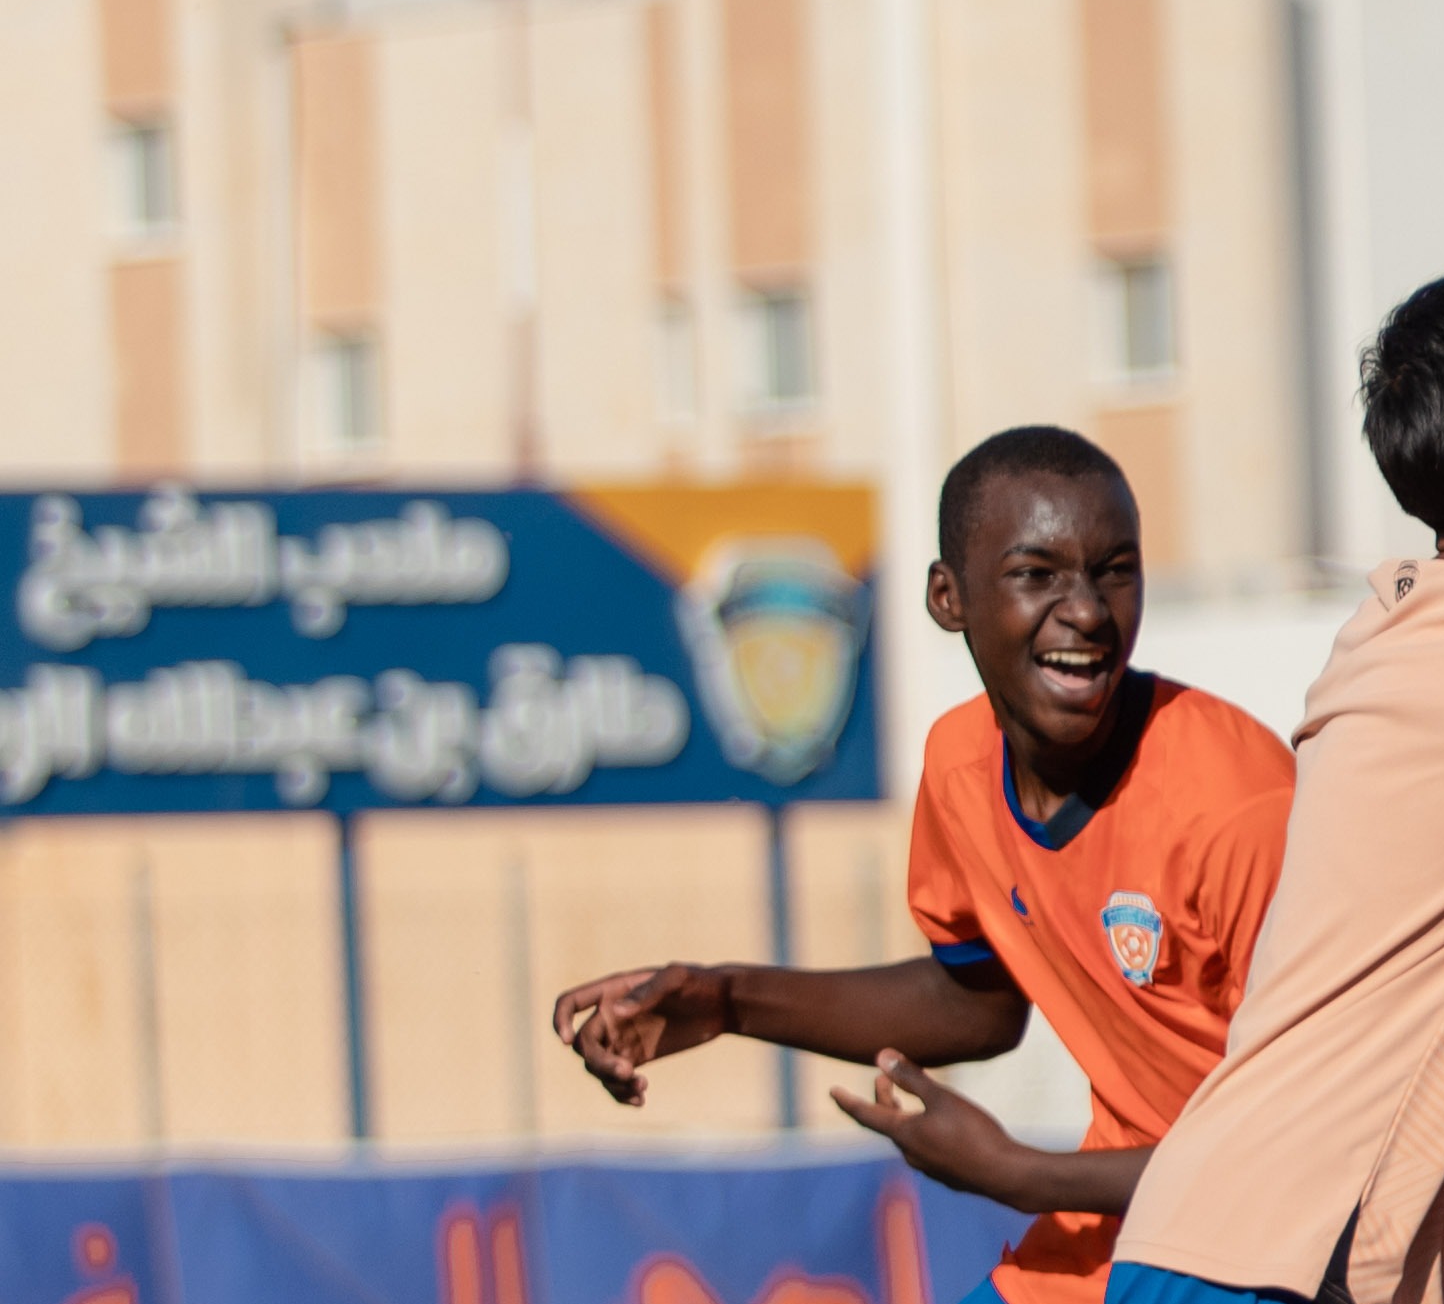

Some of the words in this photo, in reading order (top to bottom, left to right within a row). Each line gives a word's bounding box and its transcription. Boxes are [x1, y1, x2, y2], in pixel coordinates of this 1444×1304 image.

[18, 483, 276, 650] الشيخ
[282, 501, 510, 638] ملعب
[364, 668, 480, 805] بن
